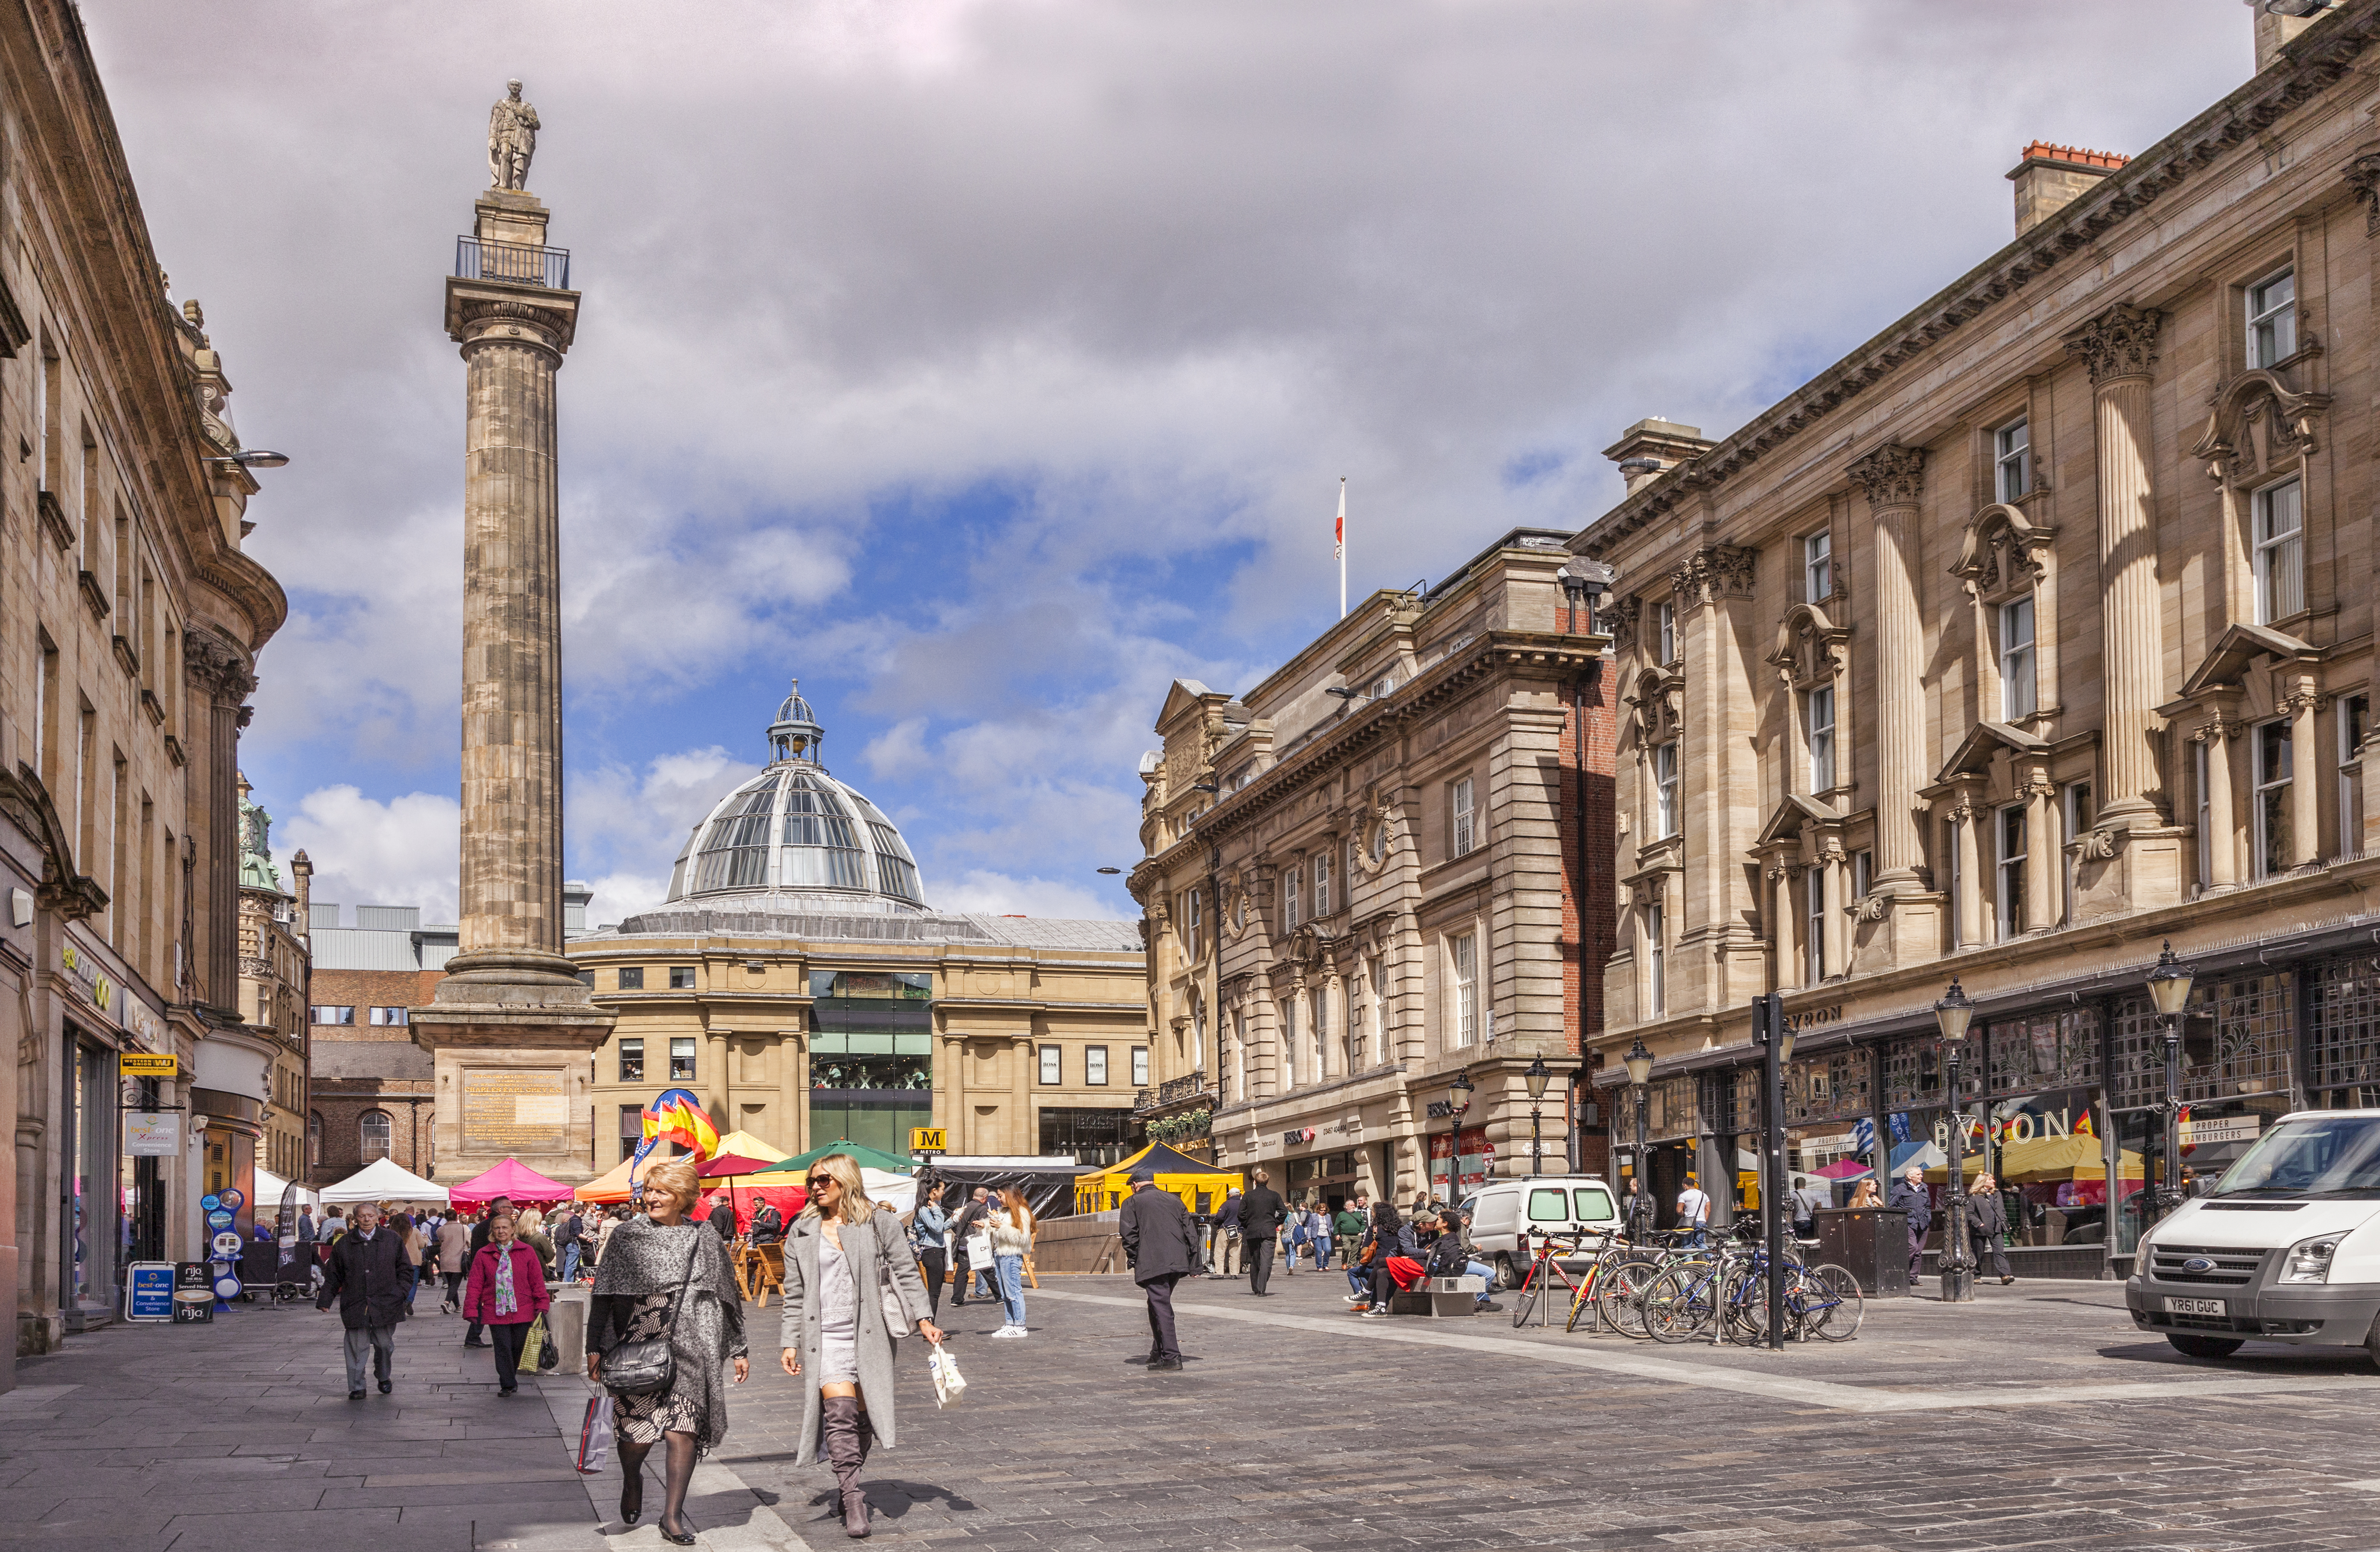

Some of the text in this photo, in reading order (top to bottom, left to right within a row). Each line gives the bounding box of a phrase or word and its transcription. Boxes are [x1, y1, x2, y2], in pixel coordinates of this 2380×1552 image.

[1783, 1005, 1841, 1029] YRON
[1427, 1100, 1452, 1118] HSBC
[1077, 1115, 1114, 1126] BOSS
[2196, 1120, 2229, 1130] PROPER
[1323, 1126, 1333, 1135] 03457
[1935, 1108, 2069, 1153] BYRON
[2185, 1130, 2241, 1143] HAMBURGERS
[921, 1131, 940, 1145] M
[1262, 1139, 1276, 1147] hsbc.co.uk
[1284, 1129, 1304, 1145] HSBC
[1818, 1136, 1839, 1145] PROPER
[1173, 1138, 1209, 1152] CHARLES GREY
[1433, 1141, 1446, 1152] Free
[1460, 1135, 1488, 1148] withdraw
[1812, 1145, 1847, 1155] HAMBURGERS
[2188, 1260, 2203, 1268] Ford
[185, 1266, 202, 1276] rijo
[2171, 1299, 2218, 1313] YR61 GUC
[182, 1308, 203, 1320] rijo
